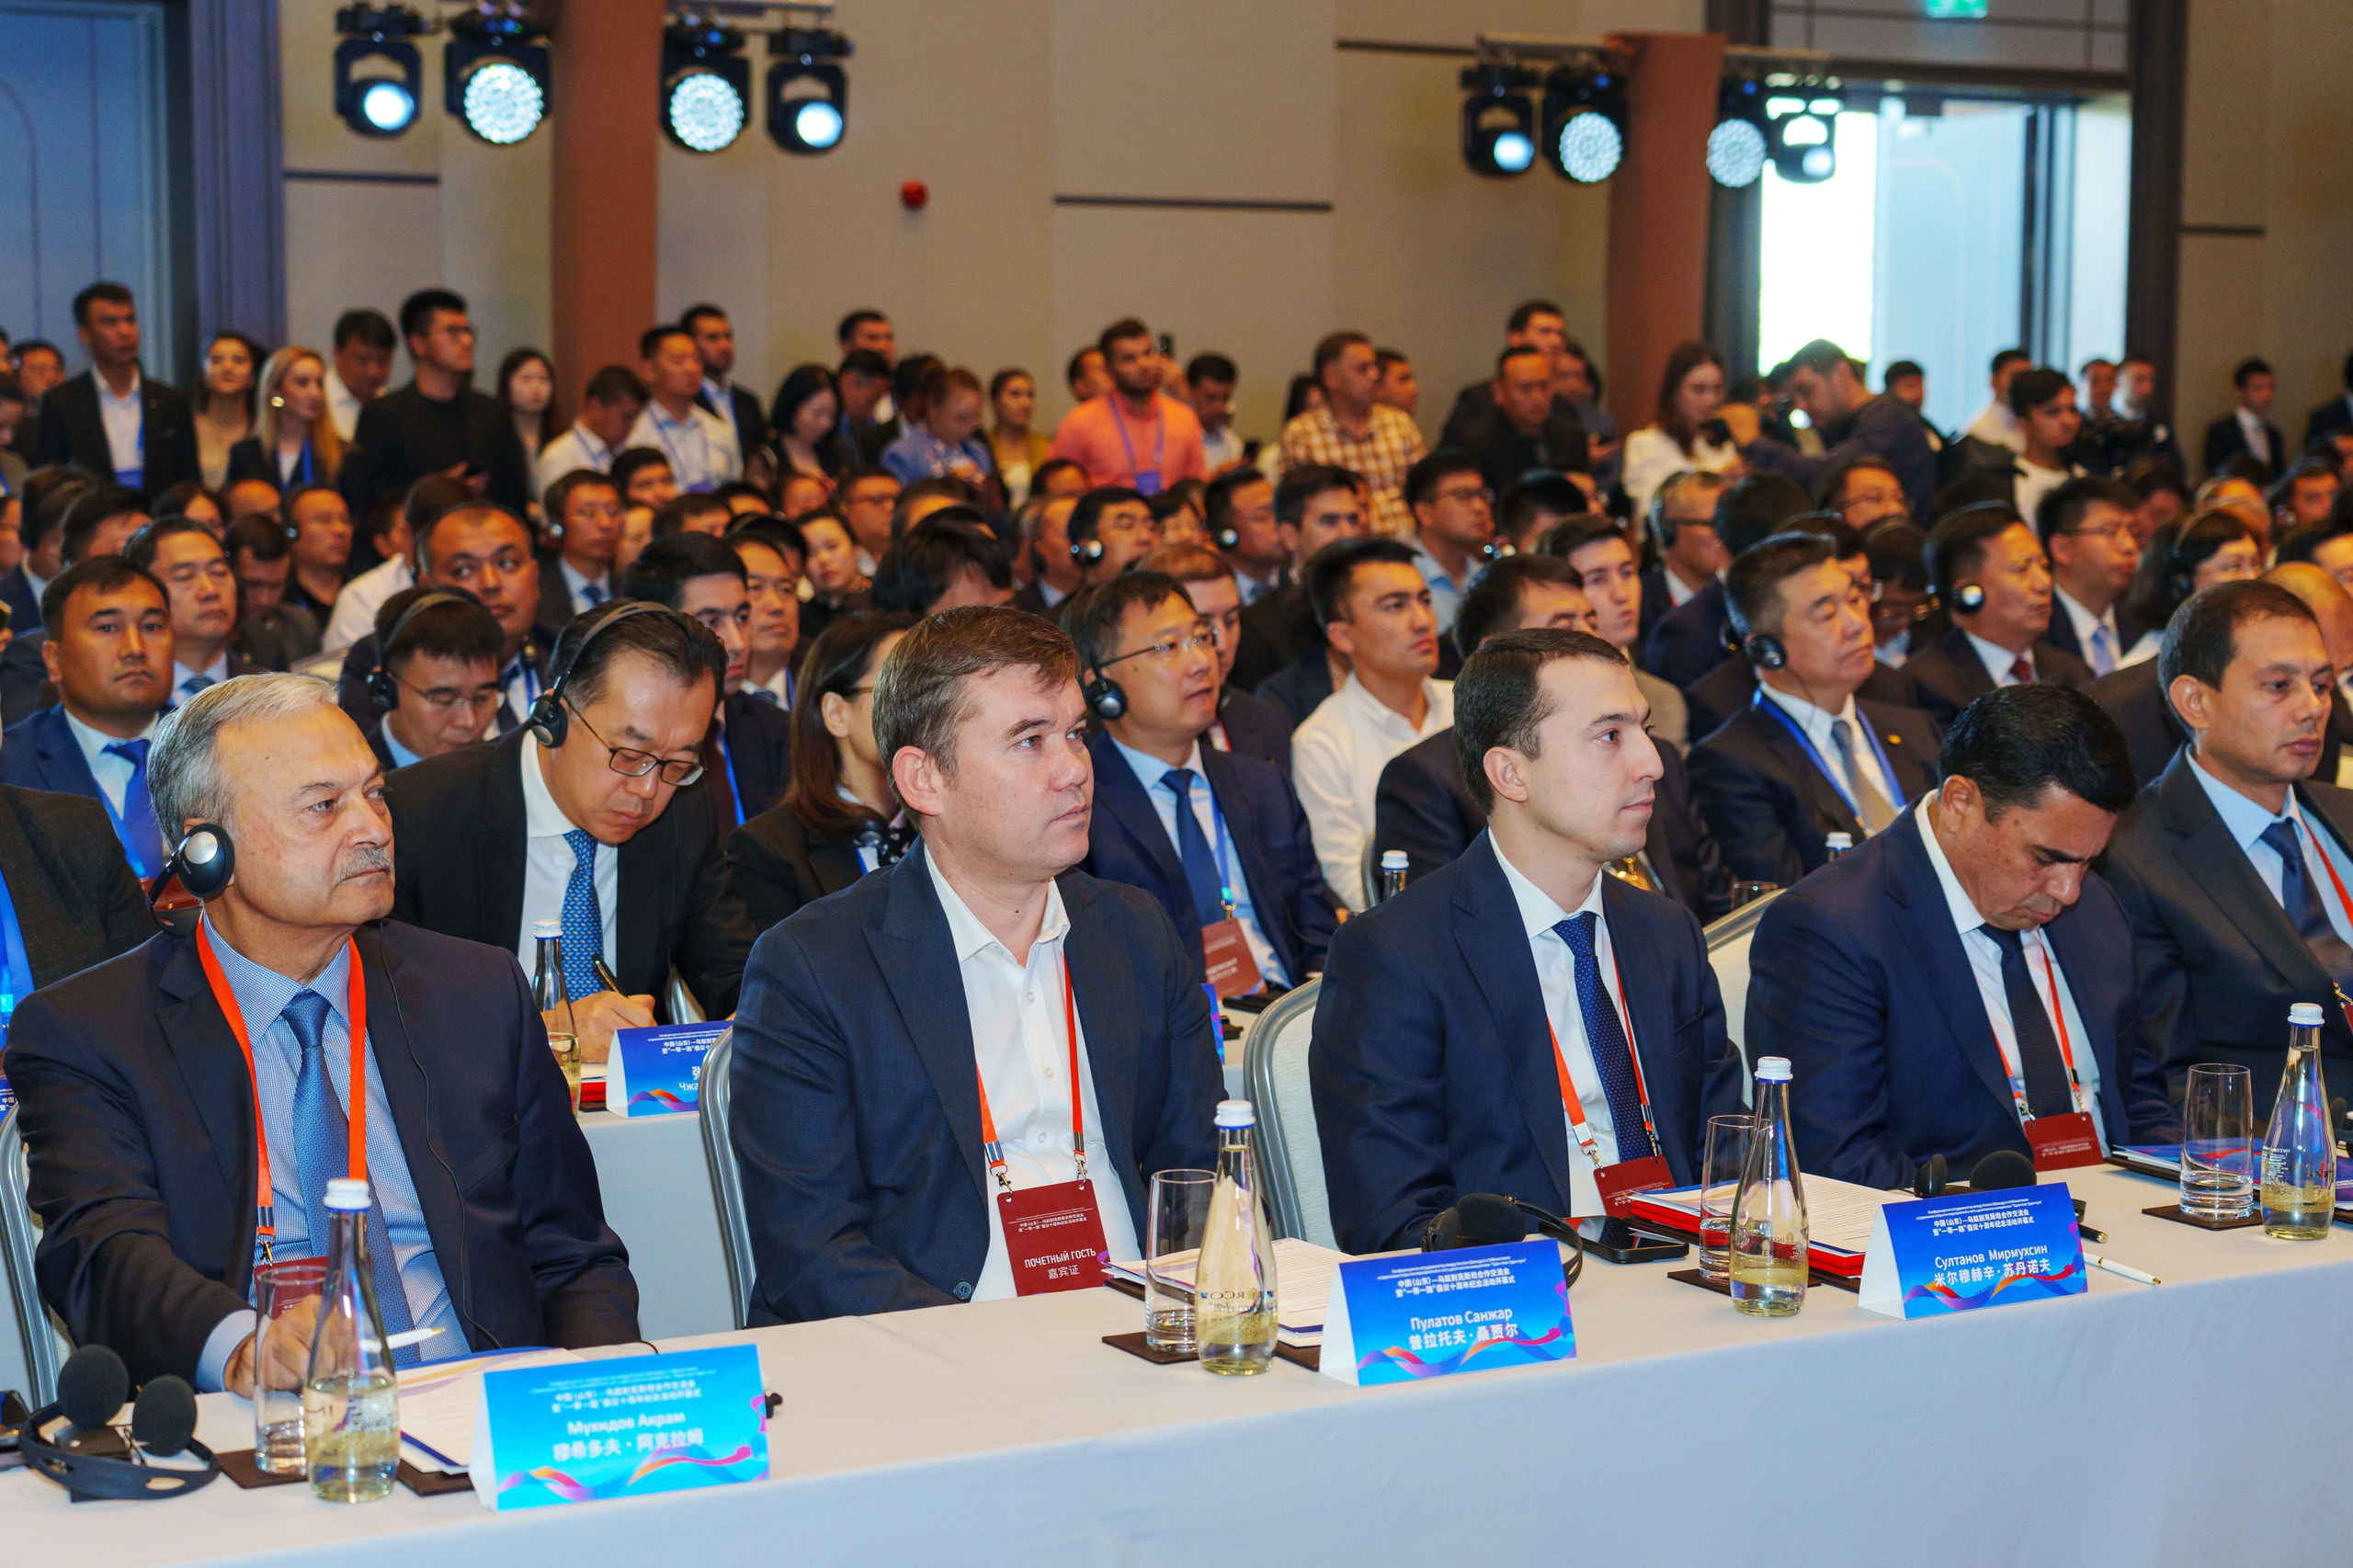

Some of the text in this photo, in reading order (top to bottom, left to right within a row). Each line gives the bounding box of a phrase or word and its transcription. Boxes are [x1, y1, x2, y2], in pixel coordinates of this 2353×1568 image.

[1024, 1248, 1097, 1268] ПОЧЕТНЫЙ ГОСТЬ
[1935, 1244, 2048, 1272] Султанов Мирмухсин
[1410, 1308, 1513, 1333] Пулатов Санжар
[1409, 1323, 1518, 1351] 普拉托夫·桑贾尔
[567, 1412, 686, 1437] Мухидов Акрам
